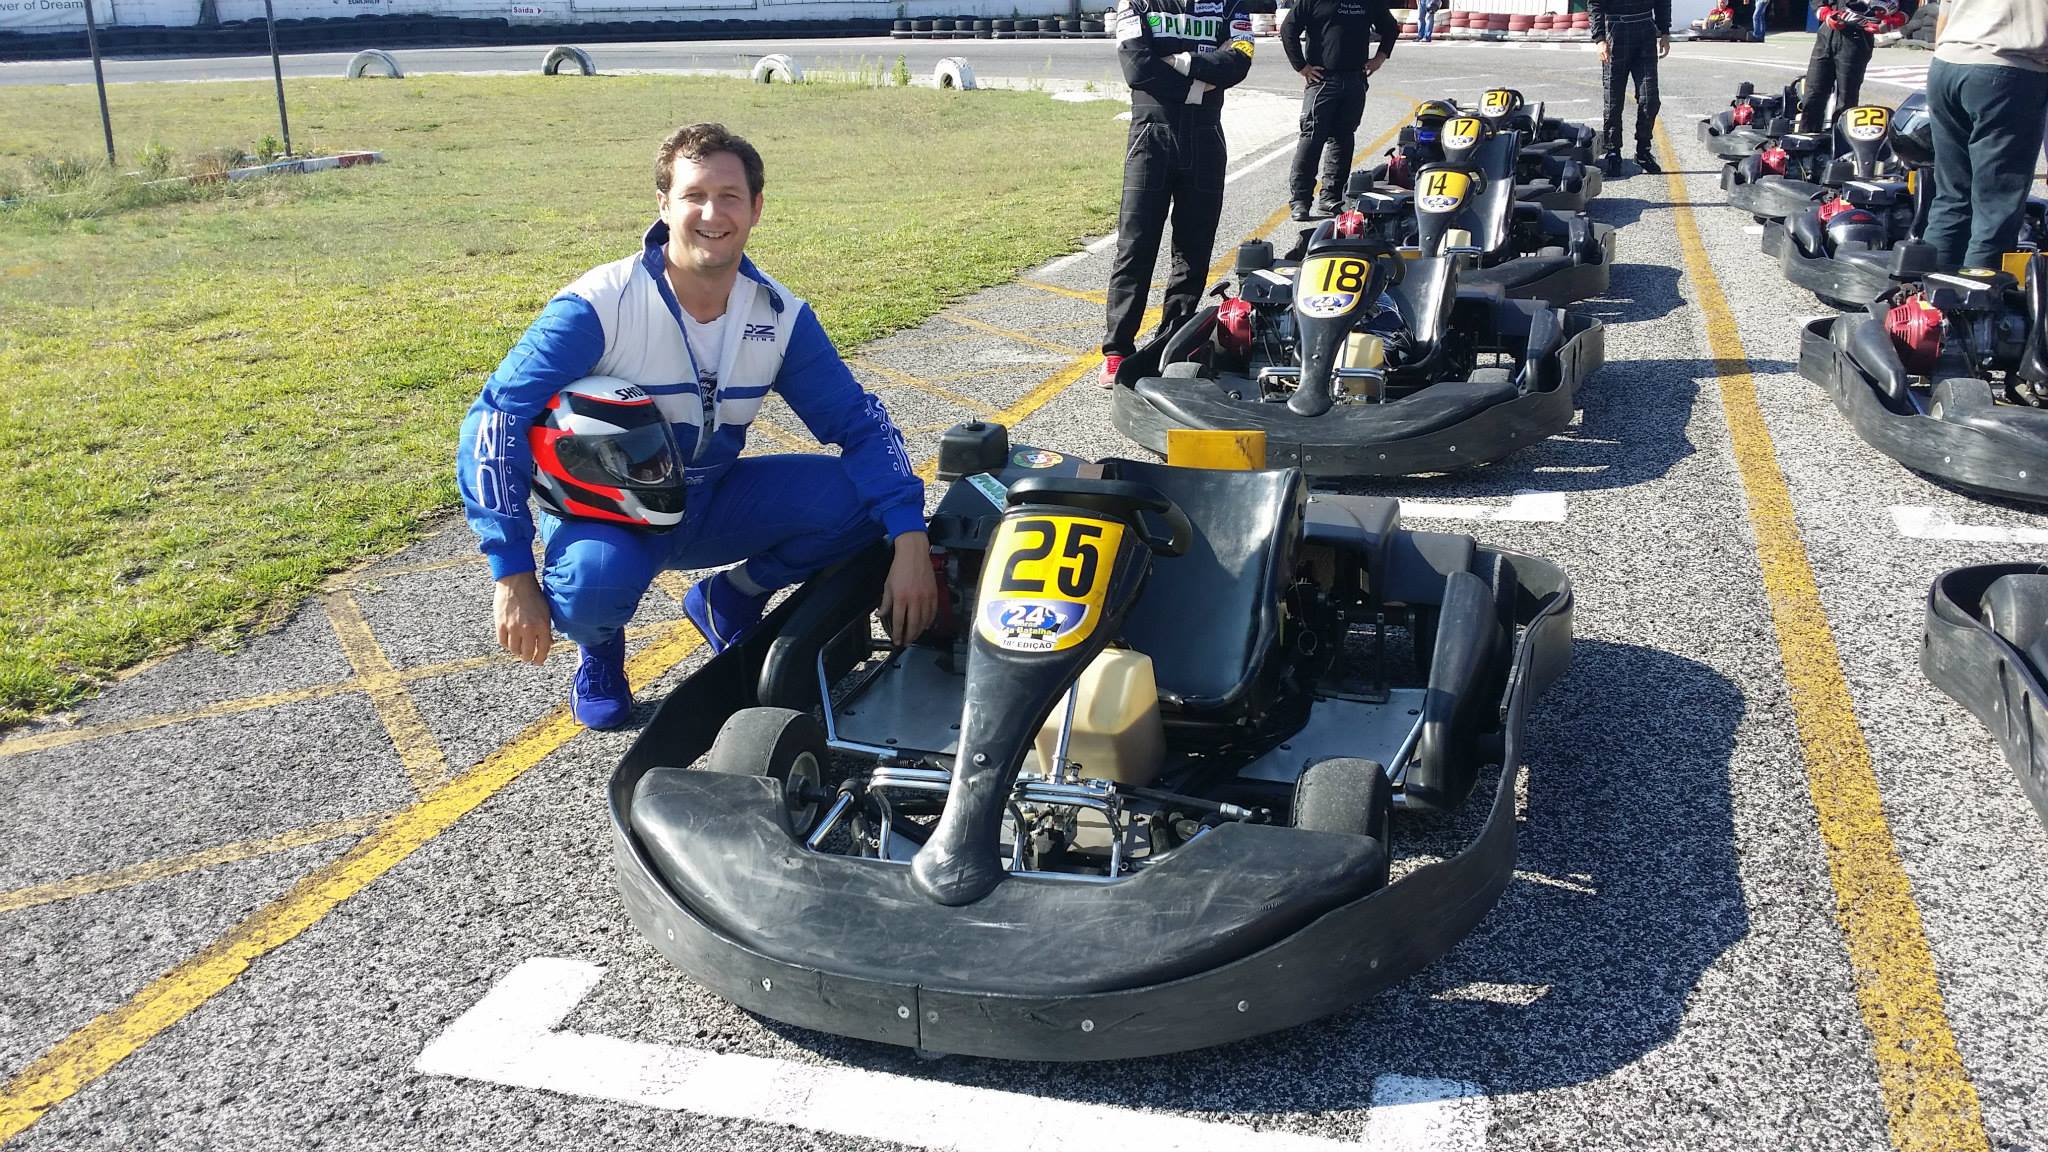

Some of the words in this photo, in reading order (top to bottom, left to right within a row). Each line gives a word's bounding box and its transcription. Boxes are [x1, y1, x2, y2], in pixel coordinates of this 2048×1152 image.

[24, 1, 36, 10] of
[1486, 92, 1510, 107] 20
[1453, 120, 1473, 137] 17
[1853, 109, 1884, 127] 22
[1426, 172, 1448, 197] 14
[1322, 259, 1366, 293] 18
[505, 414, 520, 513] RACING
[998, 519, 1104, 598] 25
[1005, 604, 1047, 627] 24
